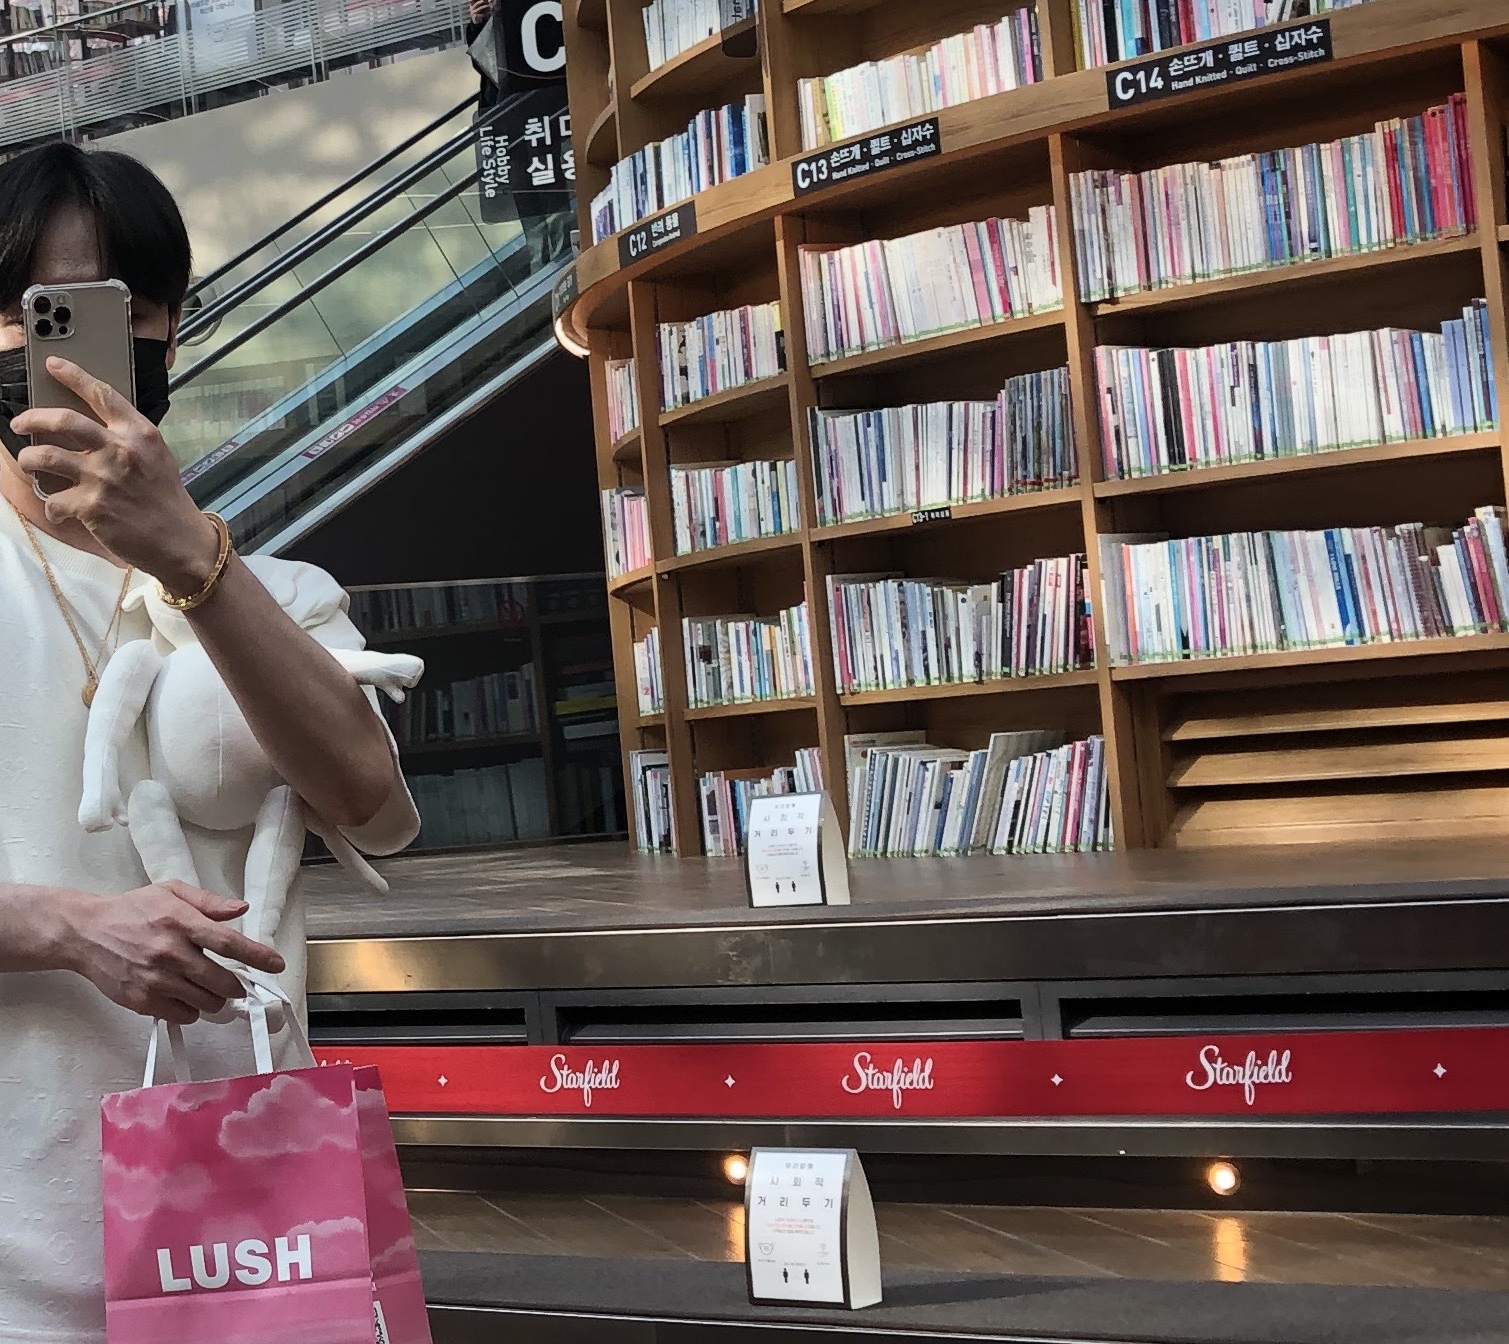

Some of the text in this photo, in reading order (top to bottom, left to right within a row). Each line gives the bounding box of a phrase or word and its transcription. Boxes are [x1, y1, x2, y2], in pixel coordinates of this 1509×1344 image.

[520, 0, 566, 72] C
[1167, 49, 1215, 77] 손뜨개
[1273, 25, 1324, 52] 십자수
[1115, 66, 1164, 101] C14
[1170, 77, 1194, 91] Hand
[1195, 69, 1228, 85] Knitted
[479, 126, 498, 198] Life Style
[495, 135, 511, 184] Hobby
[796, 158, 828, 189] C13
[629, 231, 648, 257] C12
[540, 1053, 621, 1108] Starfield
[841, 1051, 934, 1110] Starfield
[1186, 1044, 1293, 1106] Starfield
[156, 1234, 314, 1293] LUSH
